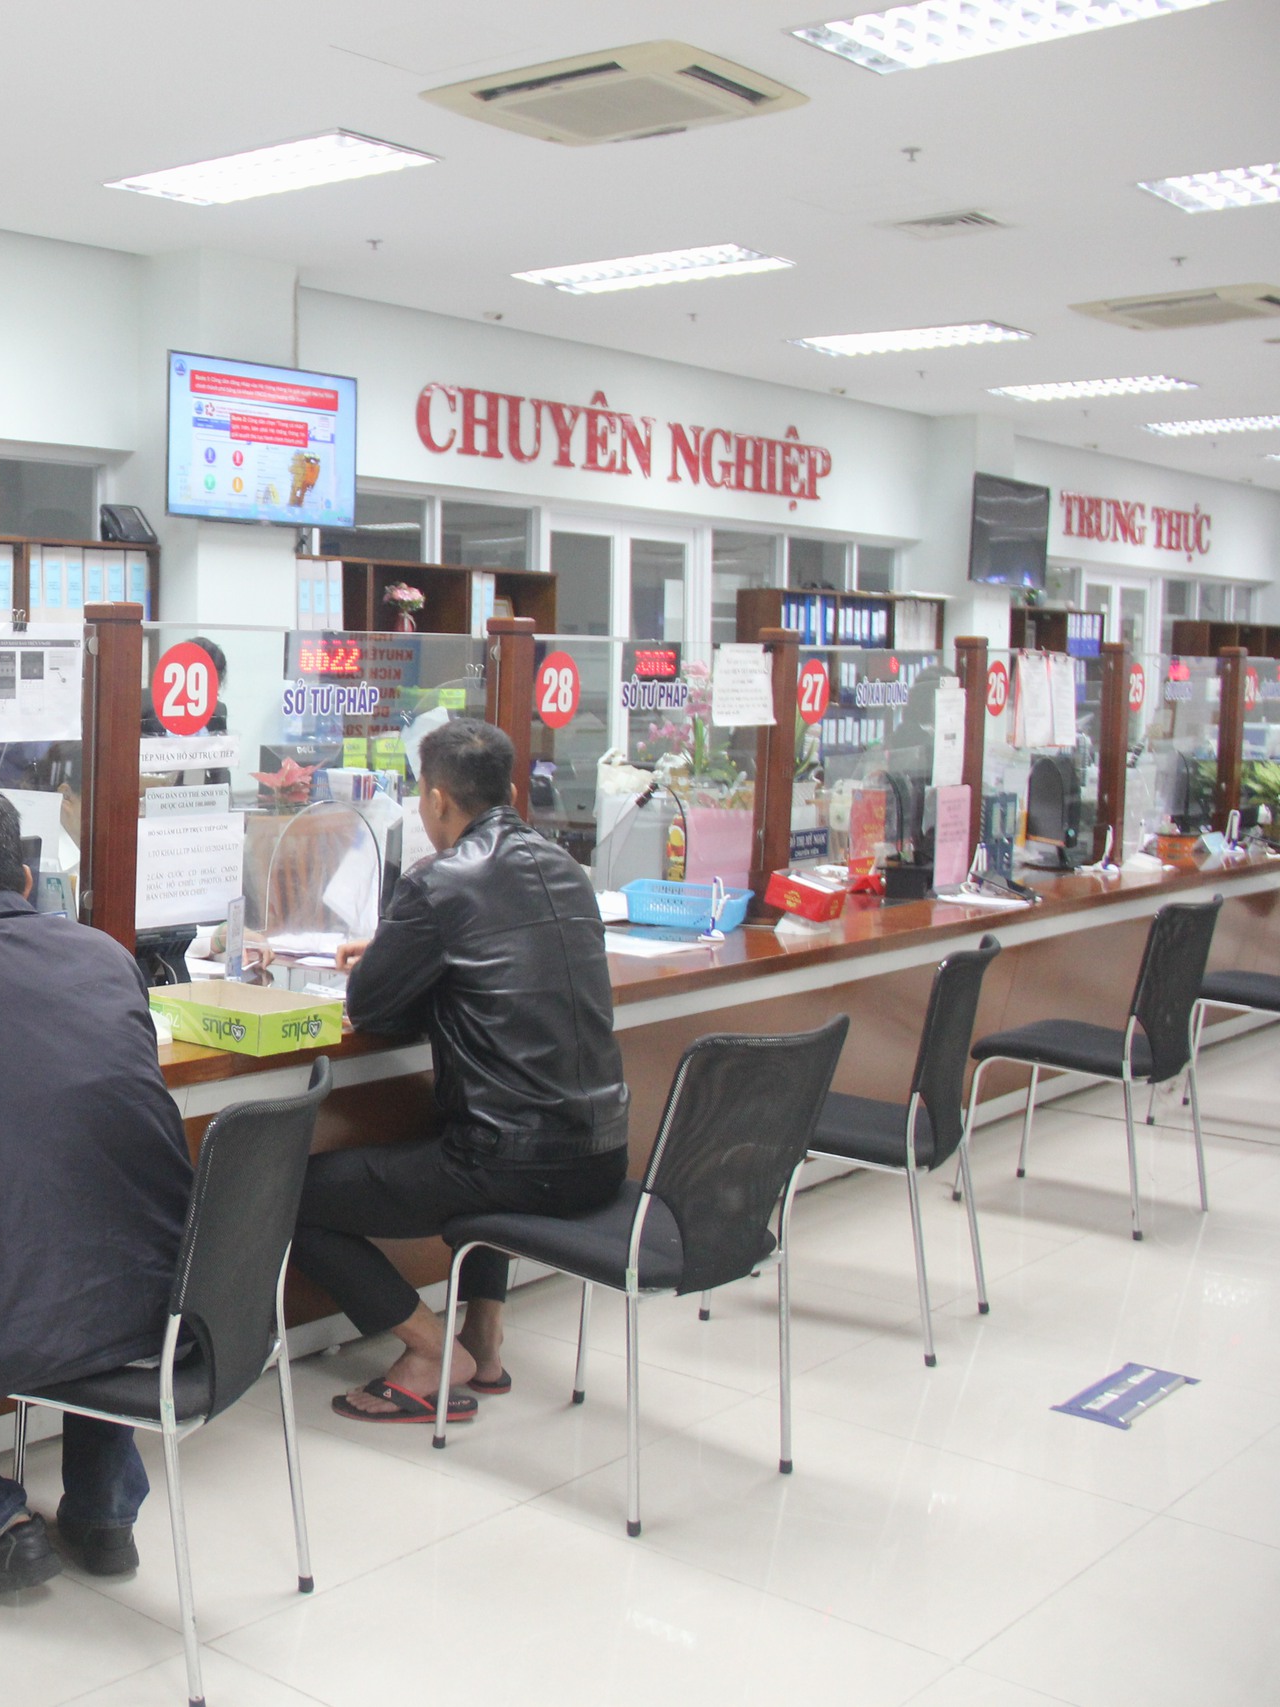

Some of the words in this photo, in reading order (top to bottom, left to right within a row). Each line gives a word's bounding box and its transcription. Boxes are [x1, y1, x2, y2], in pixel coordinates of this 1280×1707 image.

[415, 381, 657, 478] CHUYÊN
[667, 424, 832, 511] NGHIỆP
[1060, 490, 1147, 545] TRUNG
[1151, 502, 1212, 562] THỰC
[300, 640, 360, 672] 6622
[162, 662, 209, 708] 29
[282, 680, 307, 715] SỞ
[310, 686, 333, 715] TƯ
[335, 682, 379, 714] PHÁP
[540, 667, 574, 714] 28
[622, 676, 638, 708] SỞ
[640, 681, 656, 708] TƯ
[657, 679, 688, 708] PHÁP
[800, 673, 825, 712] 27
[987, 671, 1005, 705] 26
[1128, 672, 1144, 703] 25
